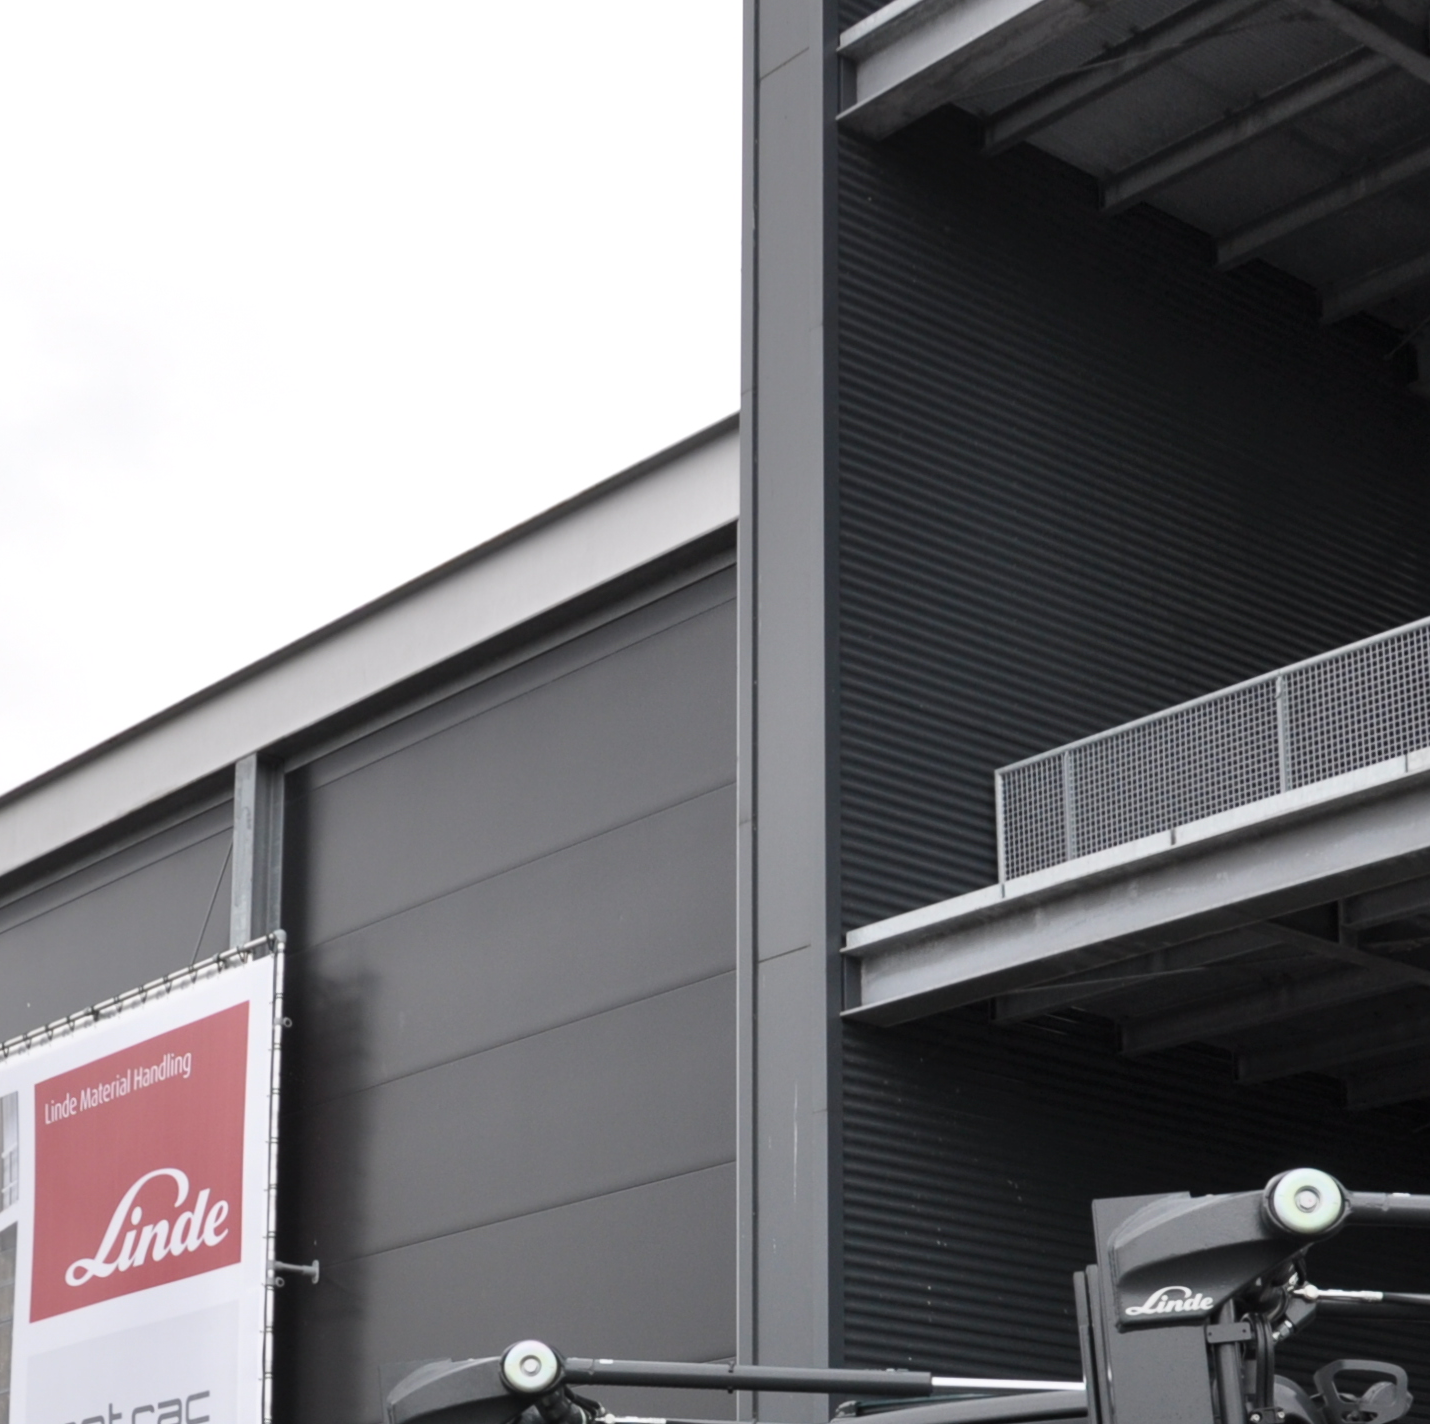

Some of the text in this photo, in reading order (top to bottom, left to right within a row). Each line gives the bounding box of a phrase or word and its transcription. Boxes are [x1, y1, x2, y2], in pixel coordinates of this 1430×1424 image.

[44, 1051, 192, 1125] Linde Material Handling
[64, 1167, 229, 1287] Linde
[1124, 1285, 1214, 1316] Linde
